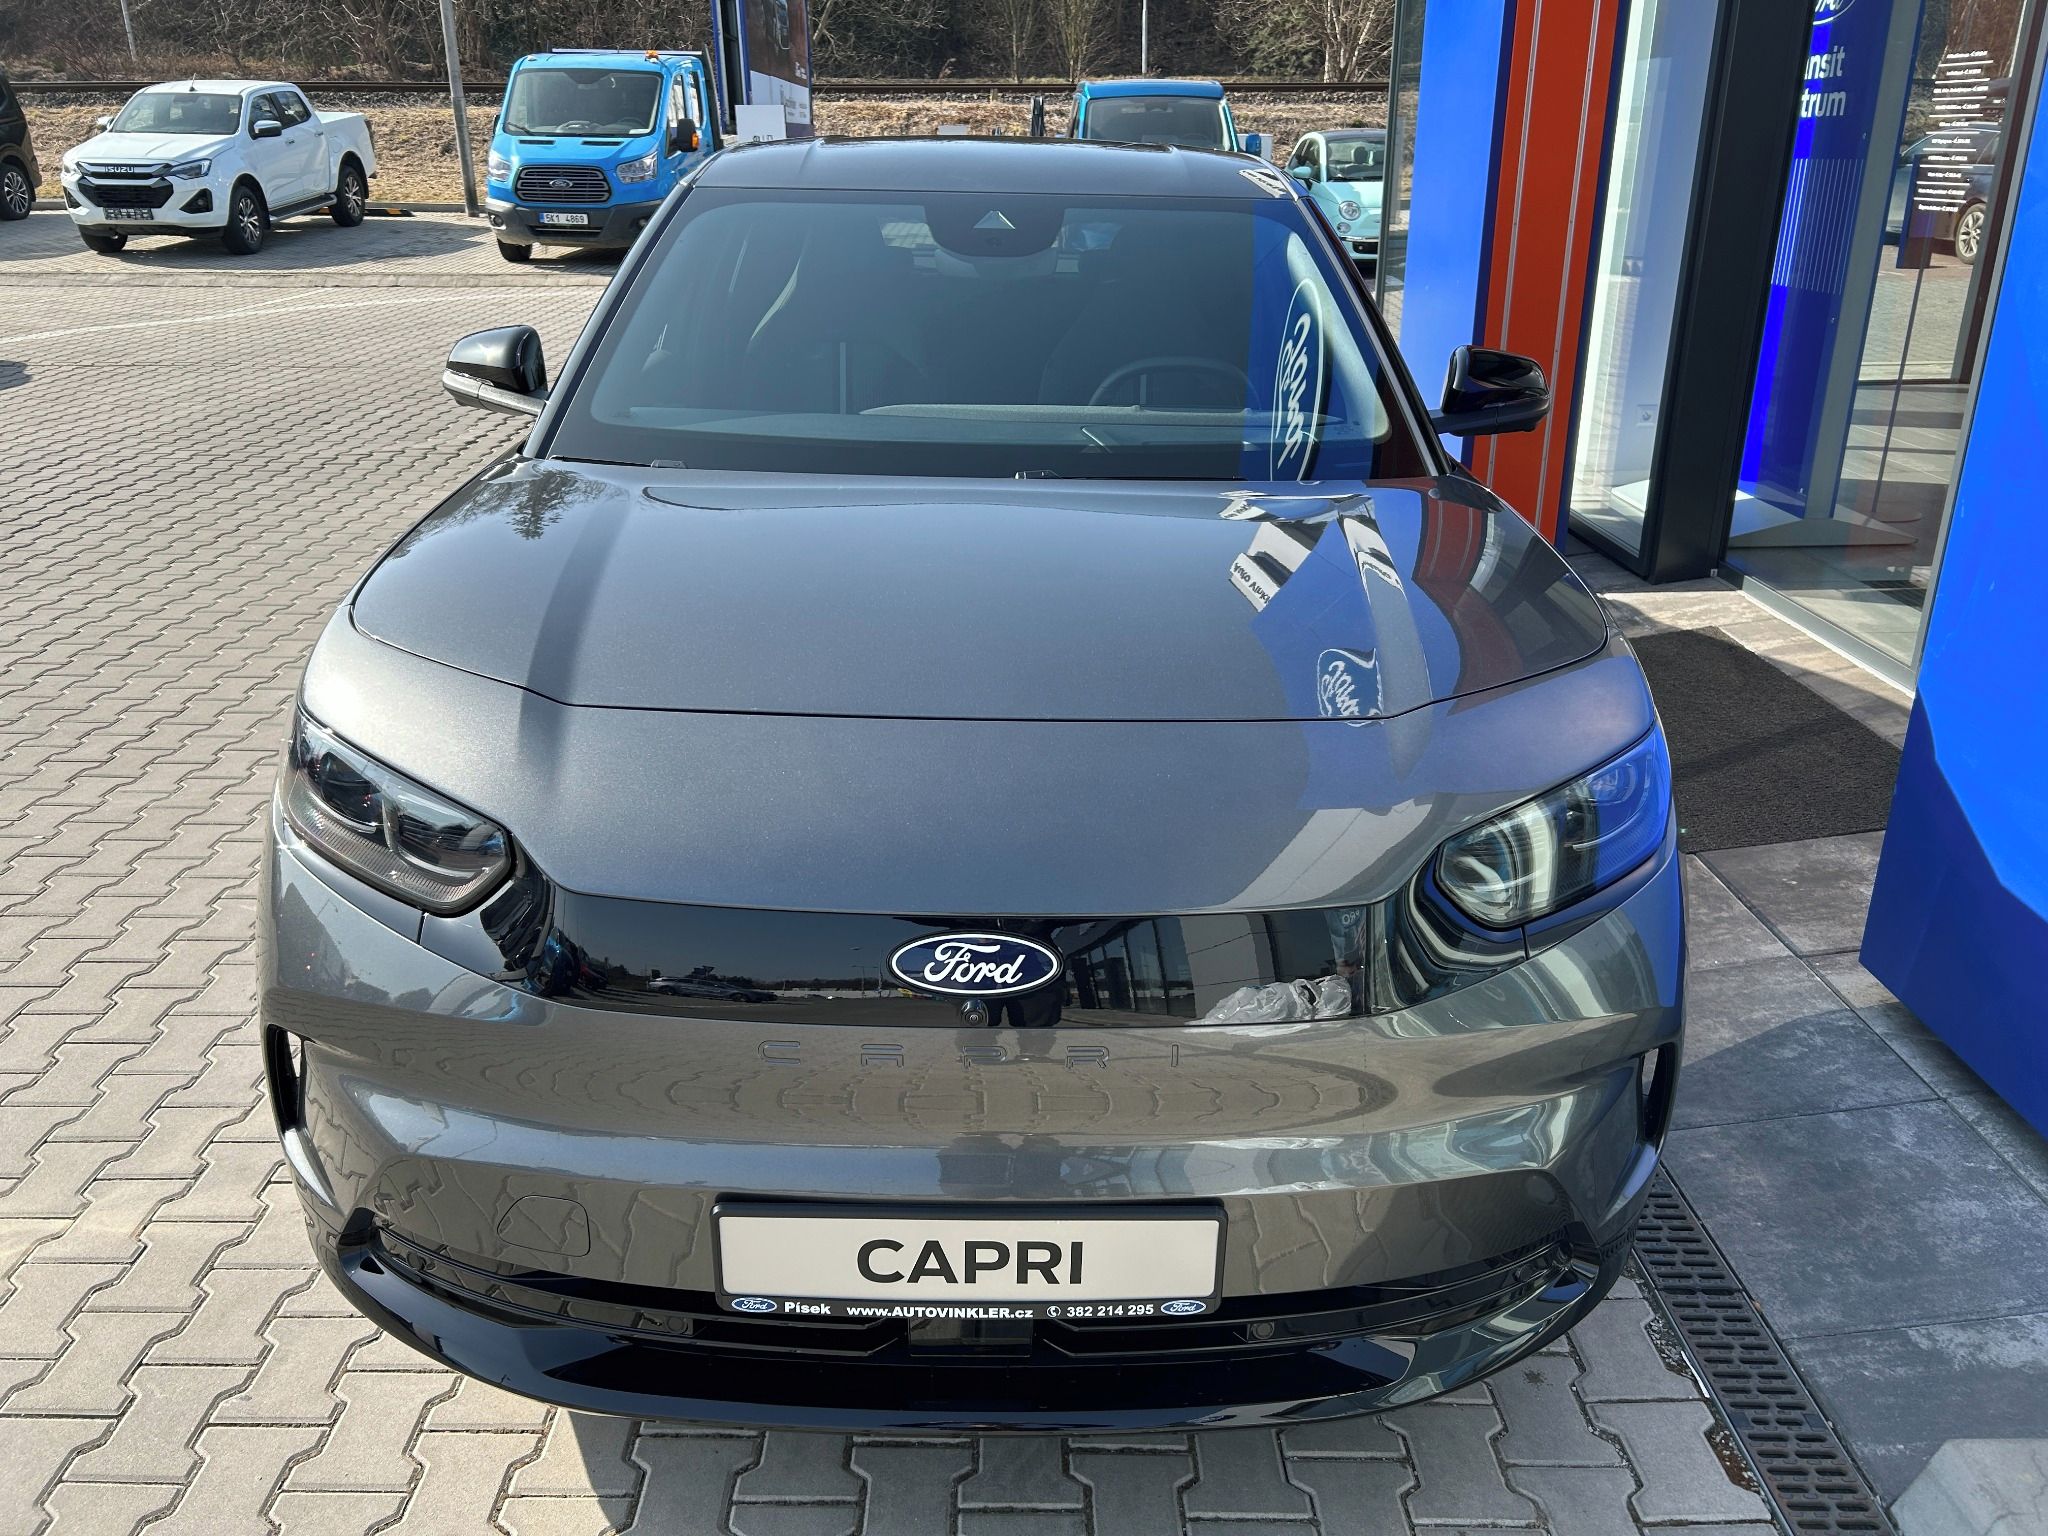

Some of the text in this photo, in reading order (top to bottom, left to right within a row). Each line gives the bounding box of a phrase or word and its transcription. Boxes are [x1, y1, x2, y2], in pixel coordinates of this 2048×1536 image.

[545, 213, 560, 223] 5K1
[924, 941, 1027, 985] Ford
[758, 1039, 1179, 1069] CAPRI
[857, 1239, 1083, 1285] CAPRI
[741, 1300, 1196, 1319] Ford Písek www.AUTOVINKLER.cz 382 214 295 Ford
